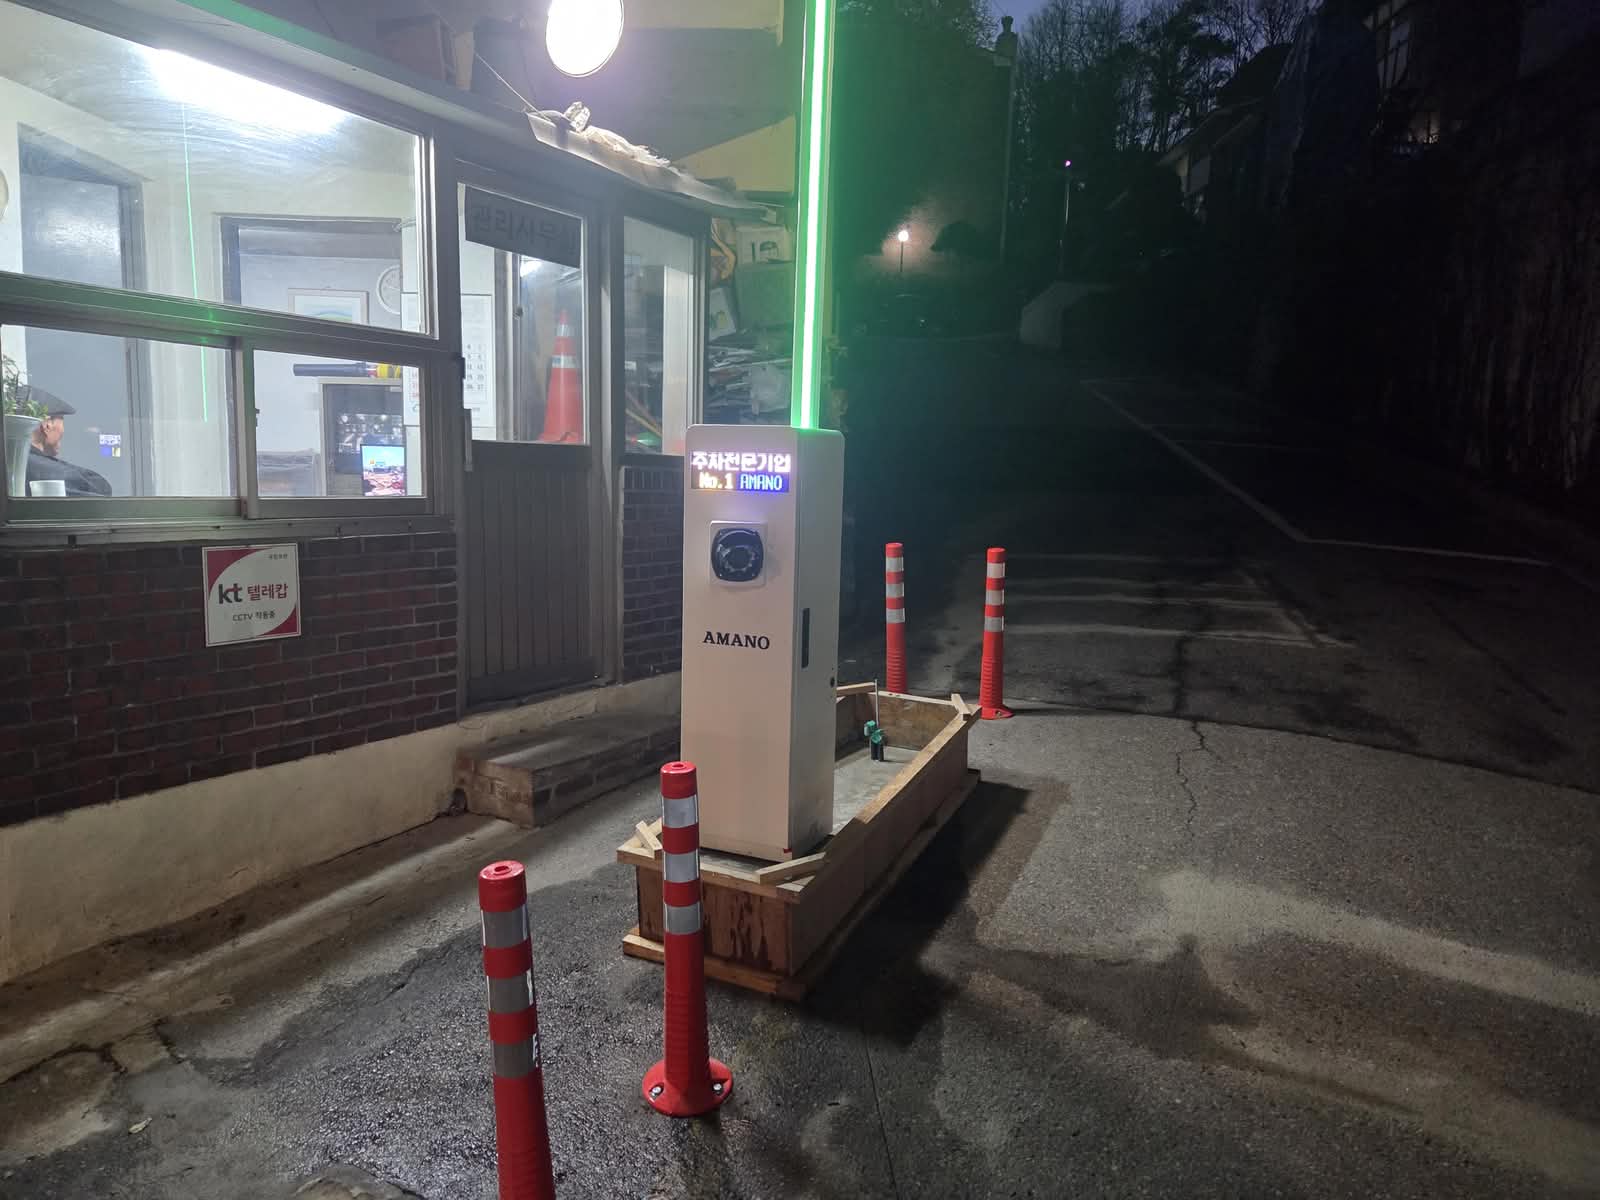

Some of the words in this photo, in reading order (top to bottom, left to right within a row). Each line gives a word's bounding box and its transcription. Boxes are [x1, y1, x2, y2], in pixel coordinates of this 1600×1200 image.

[691, 451, 791, 473] 주차전문기업
[699, 471, 734, 489] No.1
[740, 473, 783, 491] AMANO
[218, 583, 243, 605] kt
[247, 583, 288, 601] 텔레캅
[232, 612, 254, 622] CCTV
[702, 630, 770, 650] AMANO
